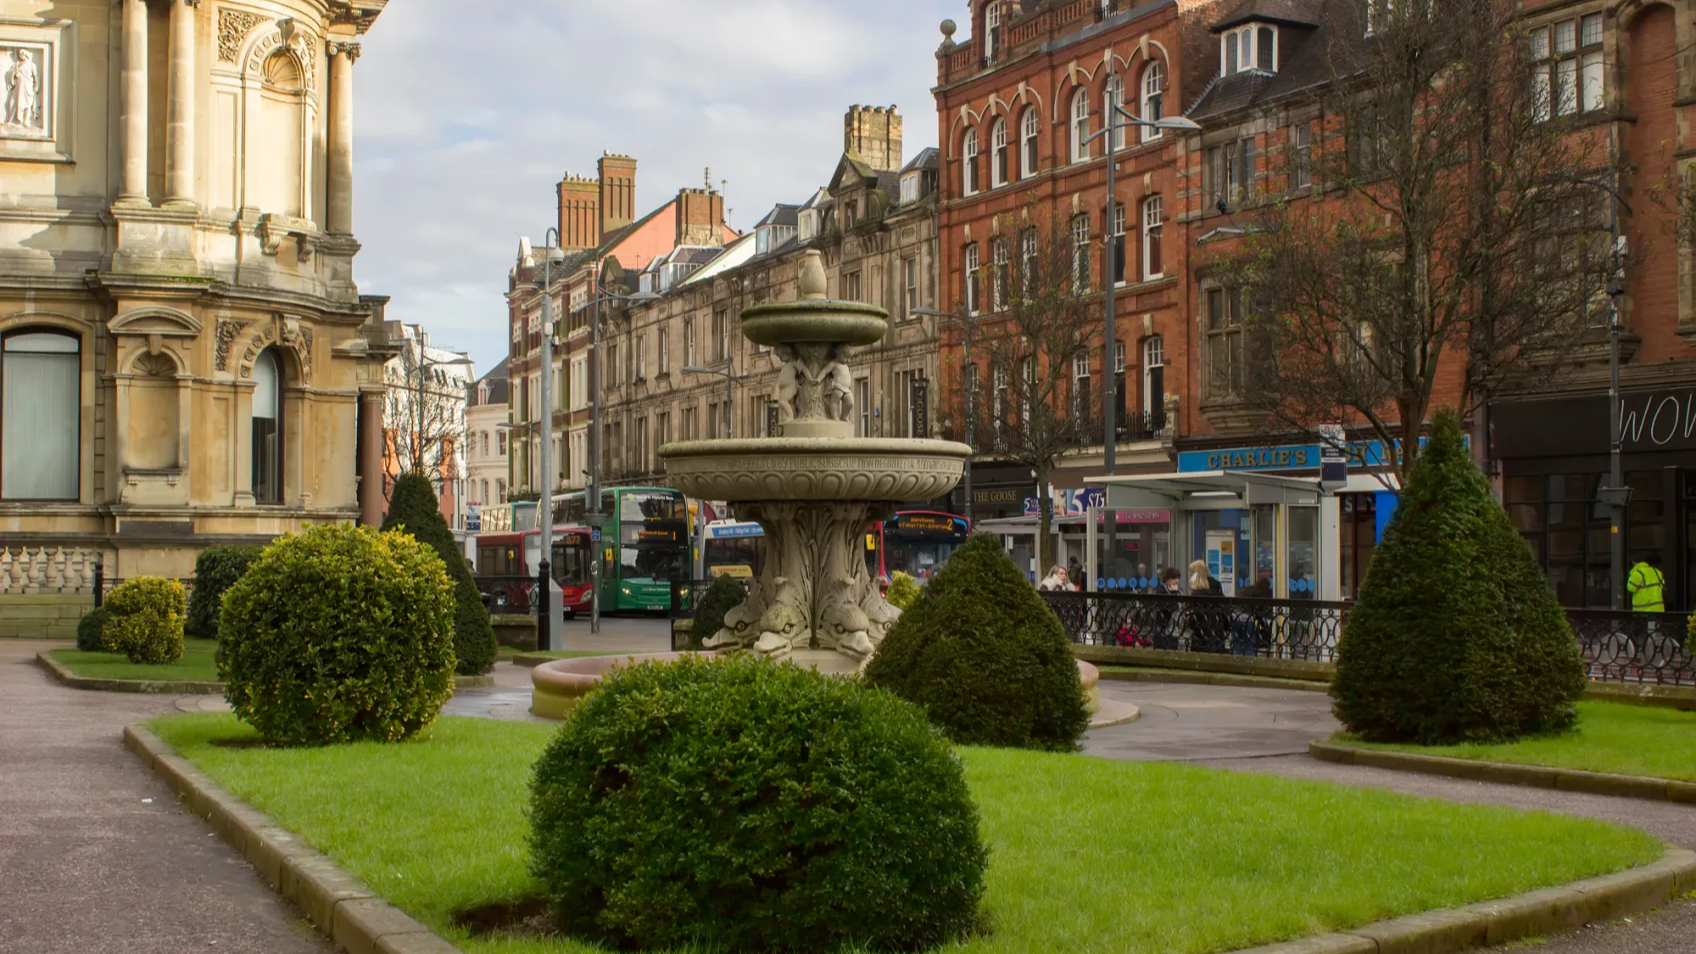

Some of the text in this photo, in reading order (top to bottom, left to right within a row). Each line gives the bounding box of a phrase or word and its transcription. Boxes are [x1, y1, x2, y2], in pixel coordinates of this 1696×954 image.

[789, 458, 816, 470] PUBLIC
[817, 457, 873, 470] SUBSCRIPTION
[1207, 449, 1307, 469] CHARLIE'S
[973, 490, 1017, 503] THE GOOSE
[1072, 488, 1086, 516] 5
[947, 518, 953, 531] 2
[672, 531, 676, 541] 1
